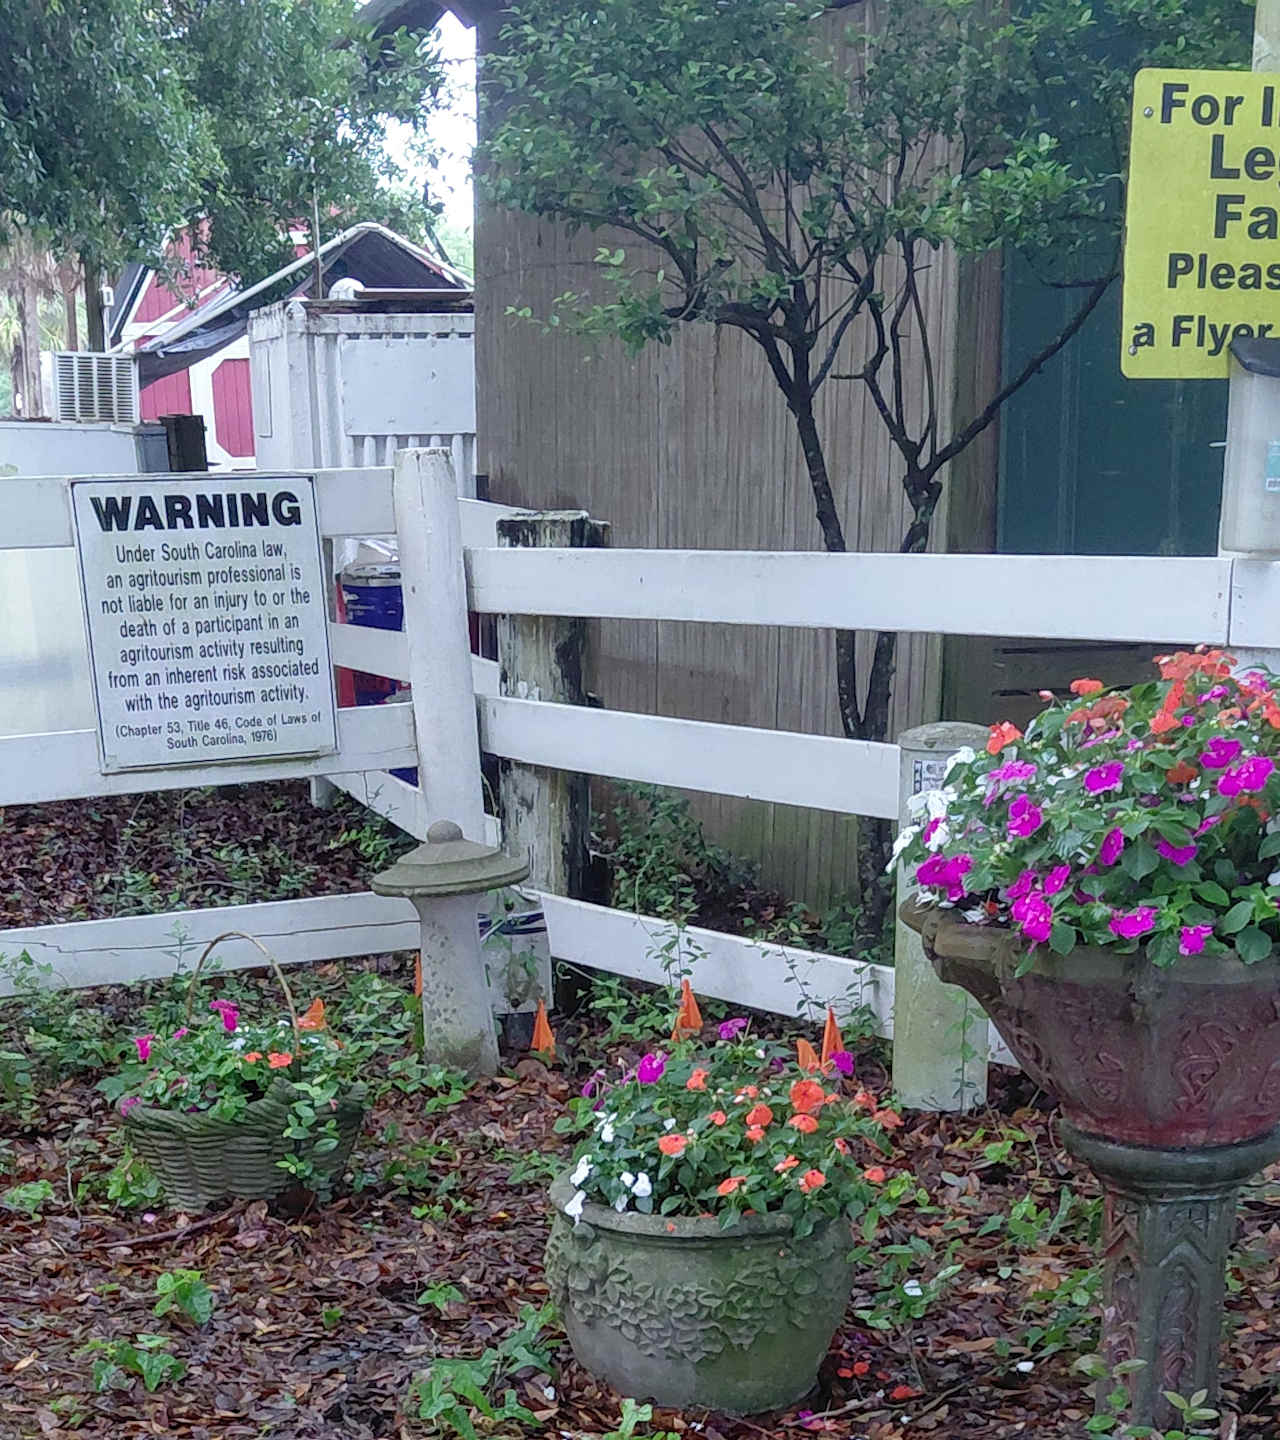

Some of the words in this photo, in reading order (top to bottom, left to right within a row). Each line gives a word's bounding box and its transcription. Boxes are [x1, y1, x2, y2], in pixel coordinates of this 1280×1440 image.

[1160, 83, 1244, 127] For
[1133, 322, 1154, 347] a
[89, 491, 302, 532] WARNING
[116, 544, 155, 563] Under
[161, 542, 200, 562] South
[204, 540, 257, 559] Carolina
[263, 540, 287, 561] law,
[107, 574, 123, 589] an
[128, 569, 202, 591] agritourism
[208, 564, 286, 587] professional
[290, 563, 302, 581] is
[101, 596, 123, 614] not
[128, 594, 163, 613] liable
[170, 593, 187, 610] for
[194, 595, 209, 609] an
[214, 591, 248, 612] injury
[254, 590, 267, 606] to
[272, 592, 285, 606] or
[291, 587, 310, 604] the
[120, 621, 157, 638] death
[163, 620, 176, 636] of
[182, 621, 190, 635] a
[195, 616, 263, 637] participant
[268, 616, 279, 630] in
[284, 615, 299, 629] an
[120, 643, 194, 666] agritourism
[199, 639, 245, 660] activity
[250, 636, 304, 656] resulting
[108, 671, 139, 688] from
[145, 671, 160, 686] an
[165, 666, 218, 685] inherent
[223, 663, 246, 681] risk
[251, 657, 320, 679] associated
[125, 693, 152, 712] with
[158, 692, 178, 709] the
[185, 687, 255, 711] agritourism
[260, 684, 309, 703] activity.
[116, 724, 162, 738] (Chapter
[189, 720, 210, 732] Title
[235, 717, 262, 729] Code
[267, 714, 277, 726] of
[281, 713, 307, 725] Laws
[311, 711, 320, 722] of
[167, 736, 198, 750] South
[202, 733, 246, 746] Carolina,
[252, 730, 277, 743] 1976)
